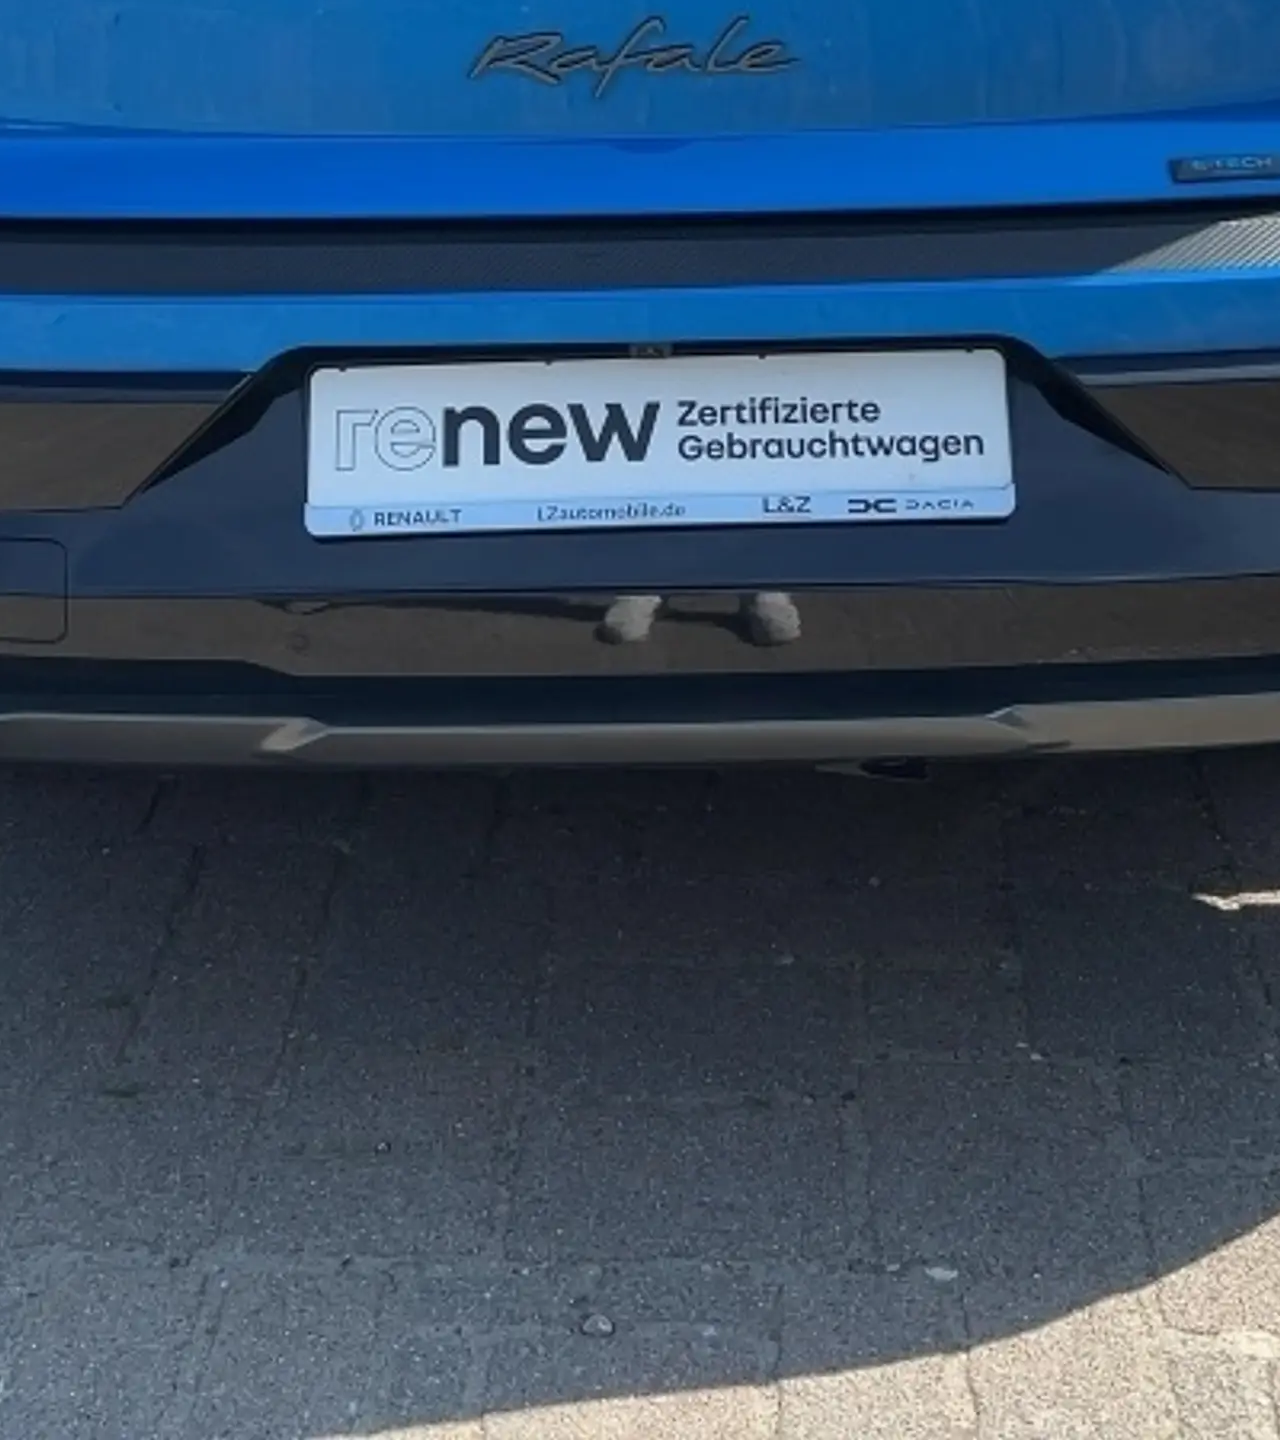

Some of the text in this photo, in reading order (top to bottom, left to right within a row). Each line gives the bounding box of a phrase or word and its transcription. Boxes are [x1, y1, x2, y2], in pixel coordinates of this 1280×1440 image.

[467, 15, 802, 98] Rafale
[676, 396, 881, 427] Zertifizierte
[334, 401, 661, 471] renew
[677, 429, 985, 463] Gebrauchtwagen
[373, 508, 462, 527] RENAULT
[762, 495, 812, 514] L&Z
[904, 498, 975, 511] DACIA
